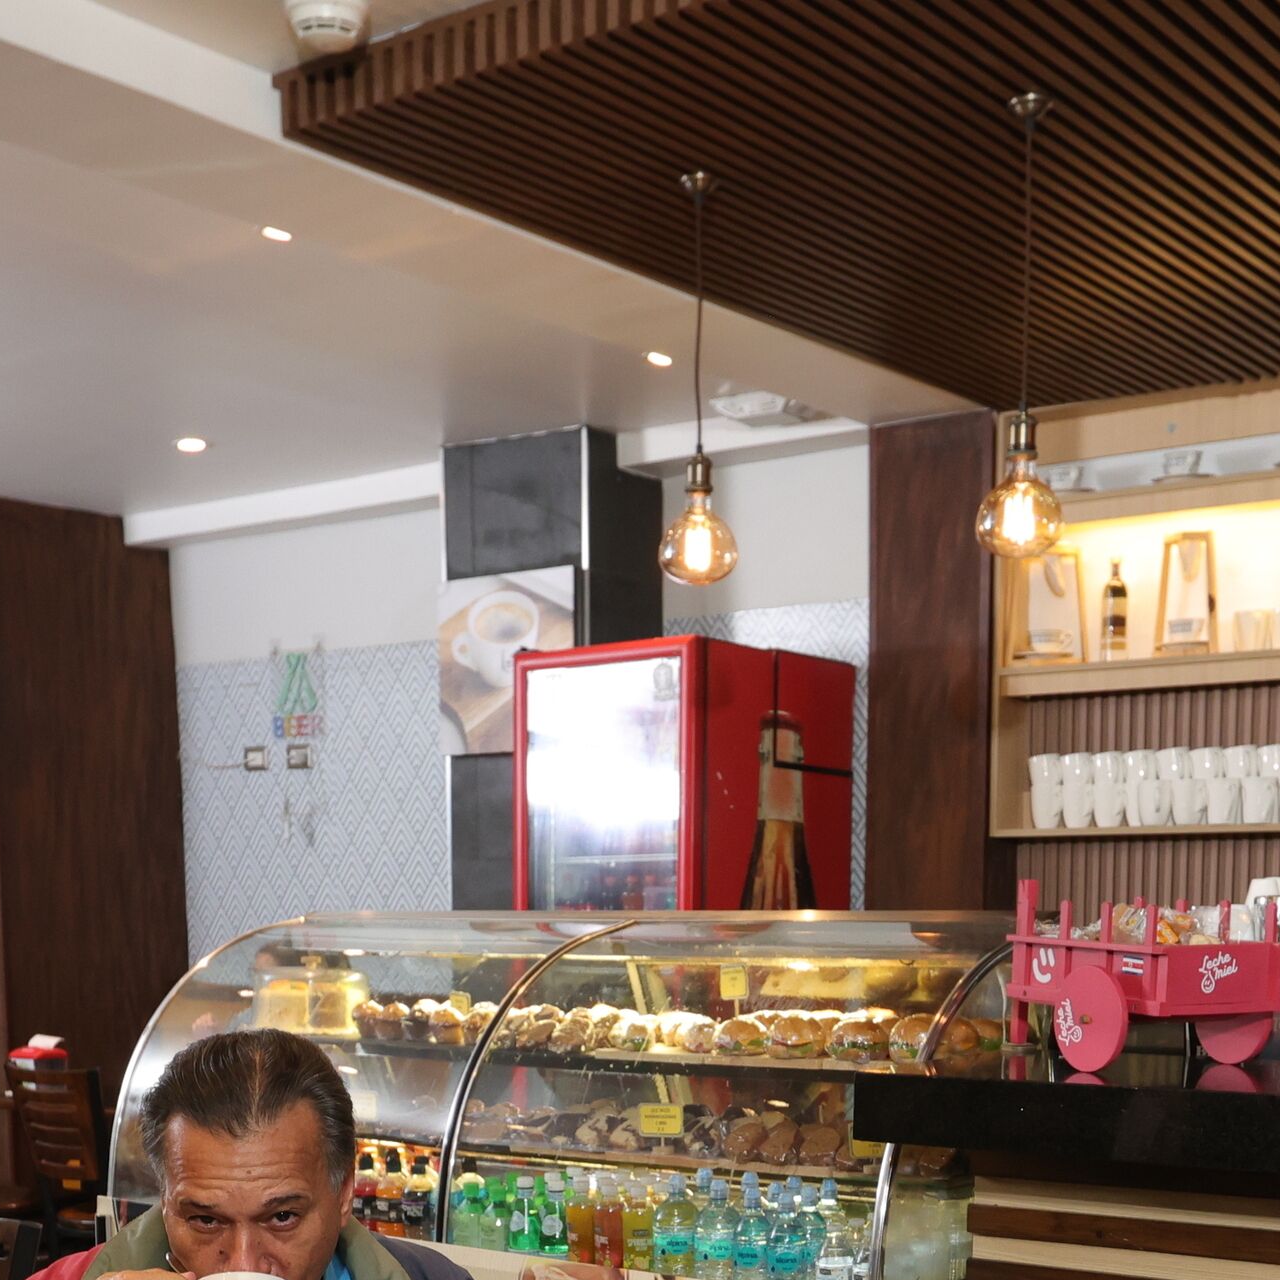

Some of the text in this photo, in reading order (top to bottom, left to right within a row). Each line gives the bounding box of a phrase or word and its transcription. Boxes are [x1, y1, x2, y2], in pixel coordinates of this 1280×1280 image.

[273, 714, 327, 739] BEER
[1198, 951, 1232, 974] Leche
[1058, 1007, 1071, 1047] Leche
[666, 1239, 688, 1248] alpina
[775, 1257, 797, 1266] alpina
